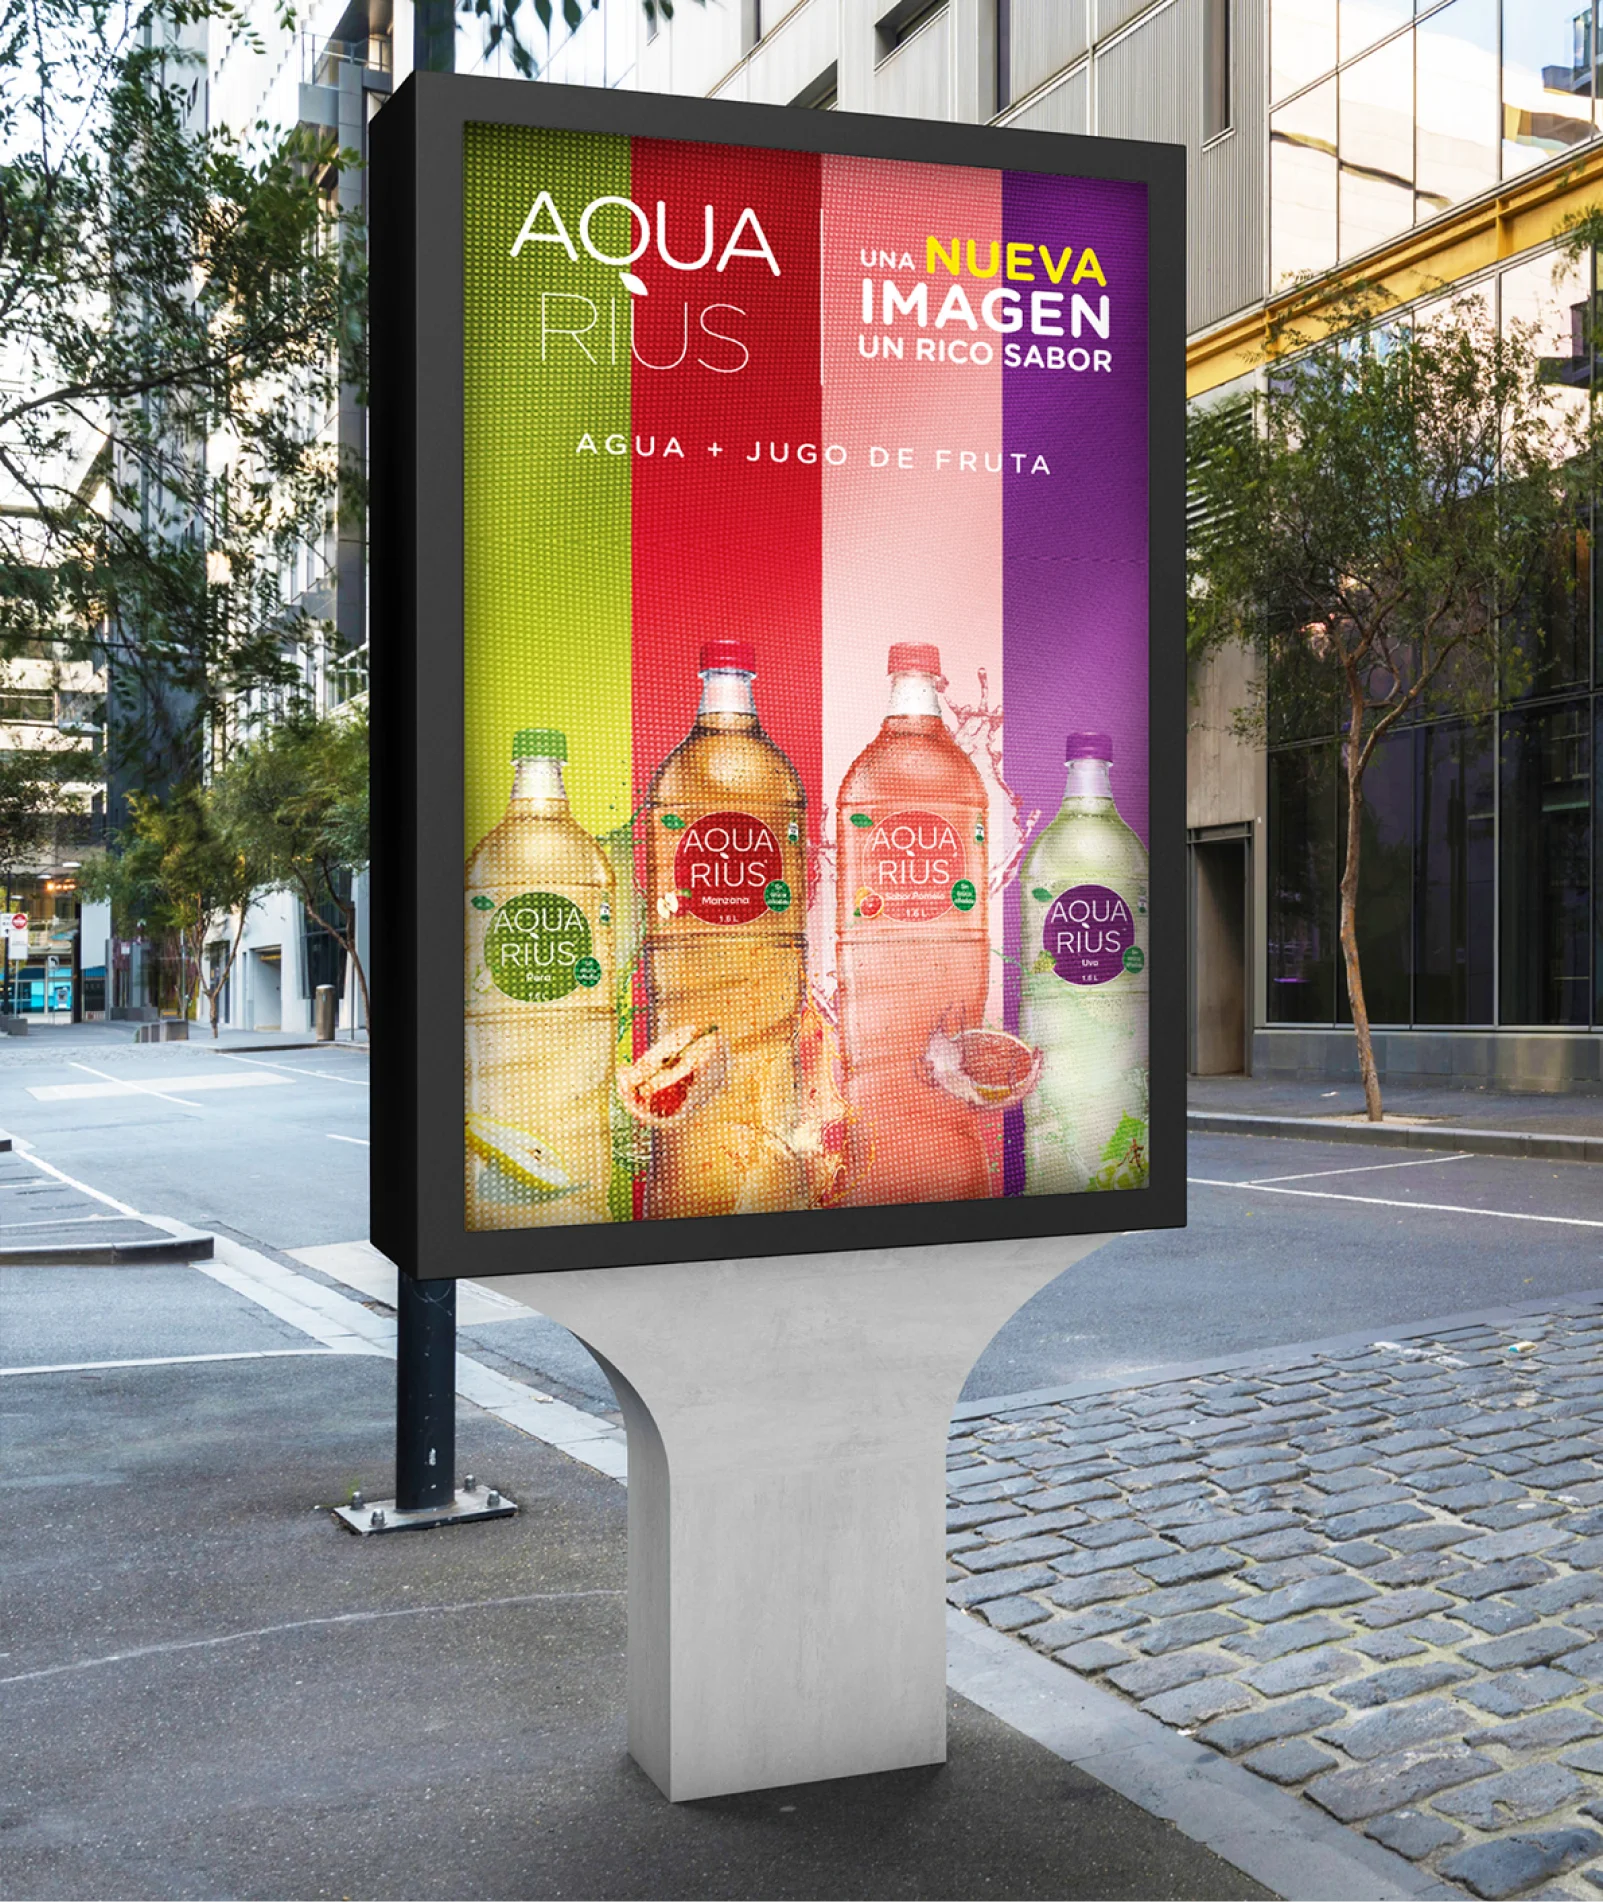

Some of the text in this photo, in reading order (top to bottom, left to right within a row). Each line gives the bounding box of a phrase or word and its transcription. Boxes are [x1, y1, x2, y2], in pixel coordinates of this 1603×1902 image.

[510, 190, 781, 296] AQUA
[860, 235, 1107, 287] UNA NUEVA
[862, 278, 1110, 339] IMAGEN
[541, 292, 749, 373] RIUS
[858, 334, 1112, 373] UN RICO SABOR
[575, 432, 685, 459] AGUA
[746, 441, 848, 466] JUGO
[869, 446, 914, 470] DE
[935, 449, 1051, 475] FRUTA
[683, 827, 774, 859] AQUA
[871, 826, 957, 857] AQUA
[690, 860, 766, 888] RIUS
[878, 858, 950, 885] RIUS
[701, 896, 749, 905] Manzana
[1050, 899, 1128, 929] AQUA
[494, 907, 583, 938] AQUA
[501, 940, 576, 967] RIUS
[1057, 930, 1121, 953] RIUS
